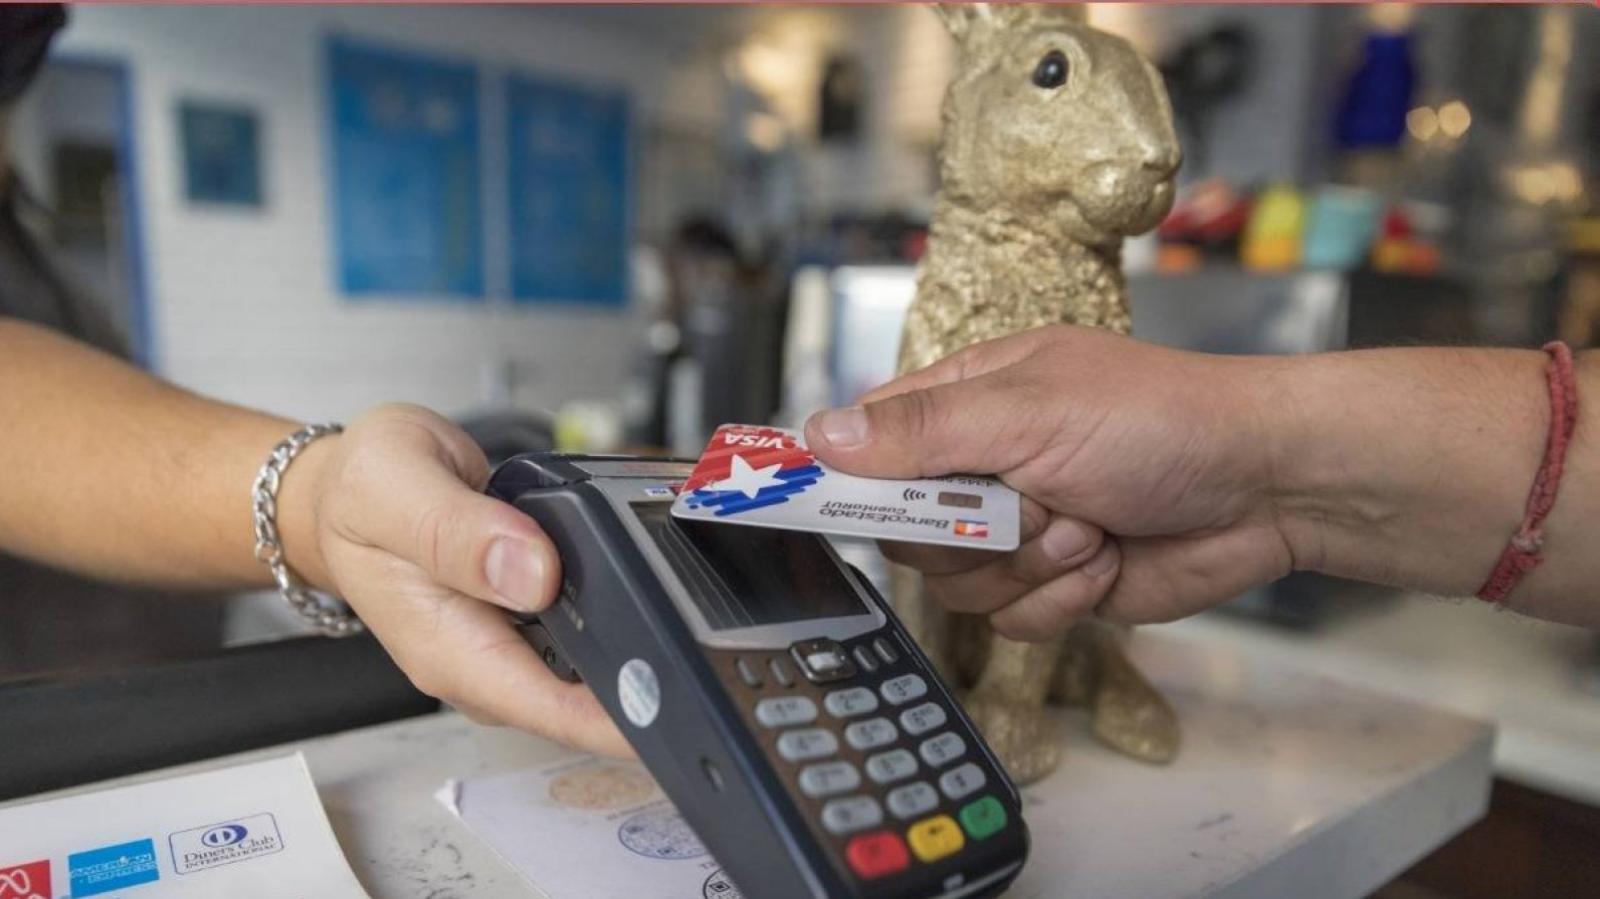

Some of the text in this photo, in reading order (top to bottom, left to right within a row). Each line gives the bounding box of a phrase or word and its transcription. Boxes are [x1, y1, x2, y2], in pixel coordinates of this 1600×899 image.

[724, 431, 785, 450] VISA
[821, 500, 908, 515] CuentaRUT
[818, 508, 950, 530] BancoEstado
[184, 834, 275, 864] Diners Club
